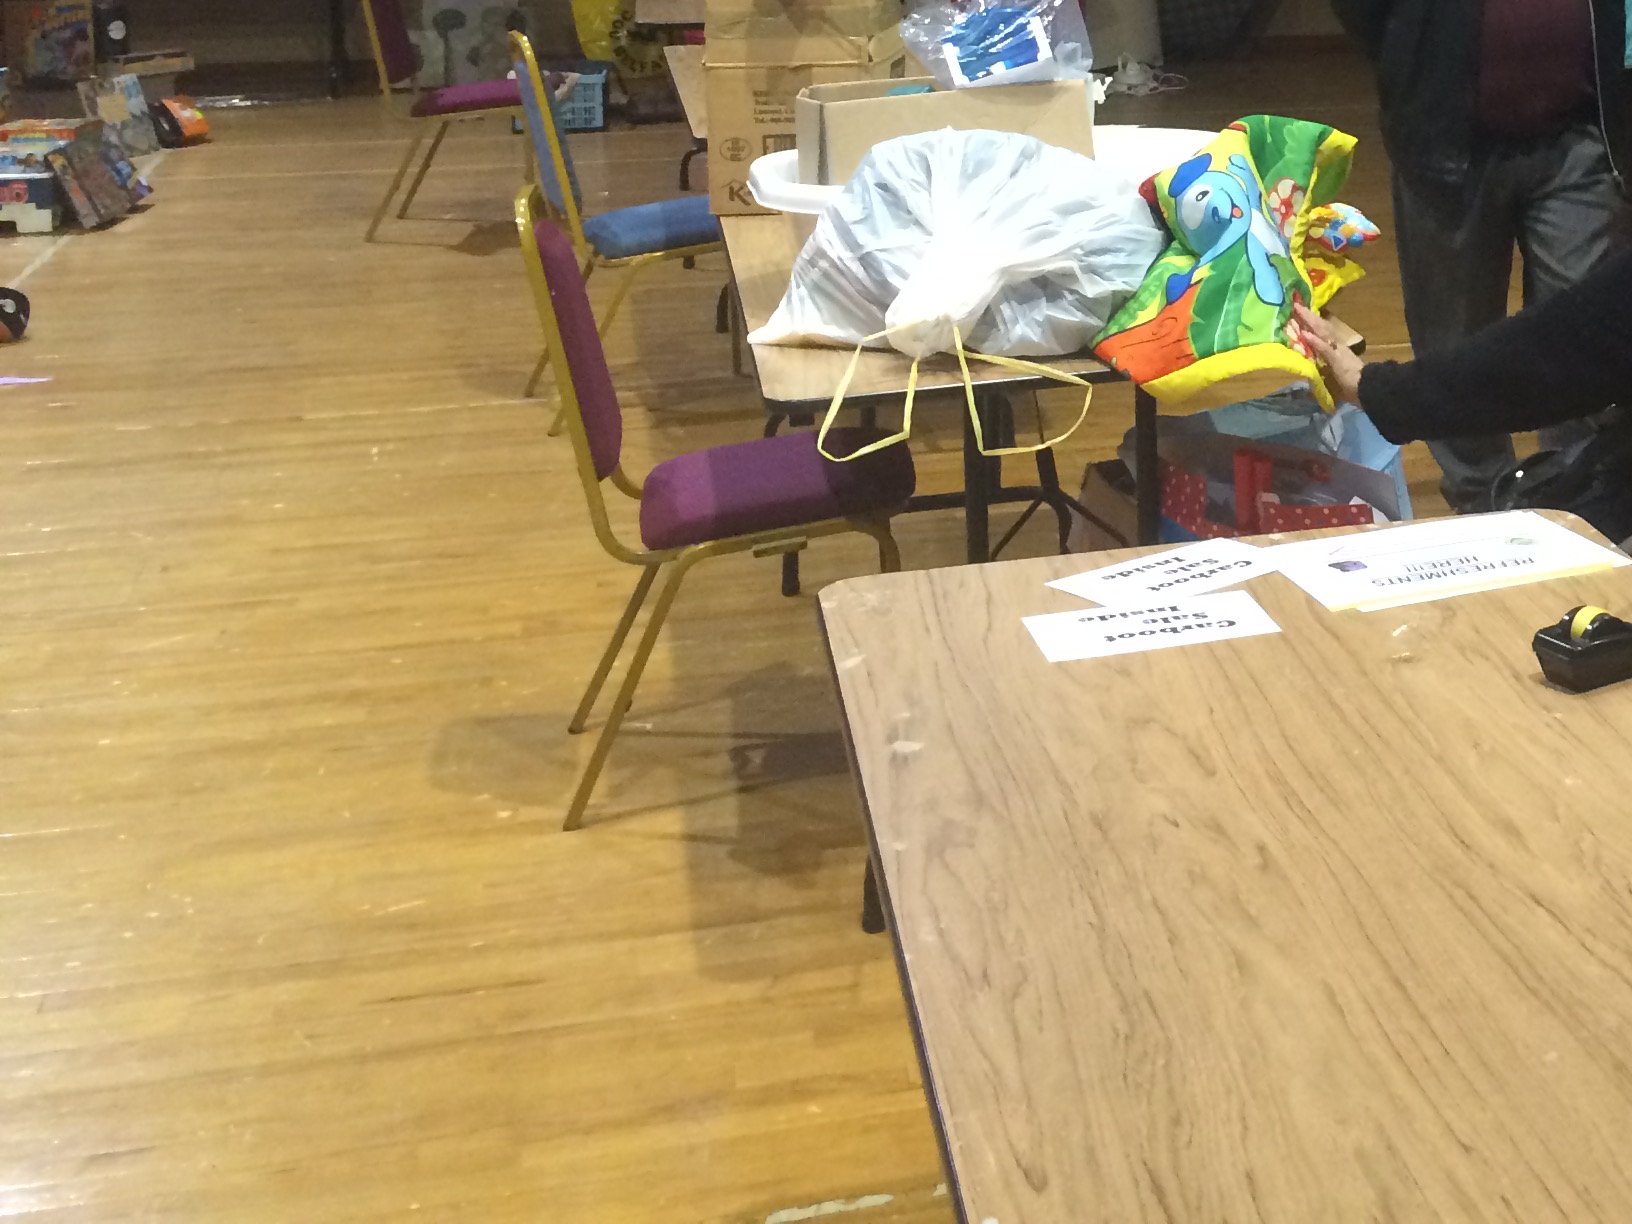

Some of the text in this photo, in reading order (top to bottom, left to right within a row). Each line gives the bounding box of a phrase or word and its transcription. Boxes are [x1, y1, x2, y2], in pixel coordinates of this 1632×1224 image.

[1101, 556, 1186, 581] Inside
[1146, 559, 1253, 592] Carboot
[1163, 557, 1220, 576] Sale
[1371, 556, 1535, 587] REFRESHMENTS
[1077, 605, 1181, 622] Inside
[1142, 612, 1209, 625] Sale
[1103, 619, 1237, 642] Carboot
